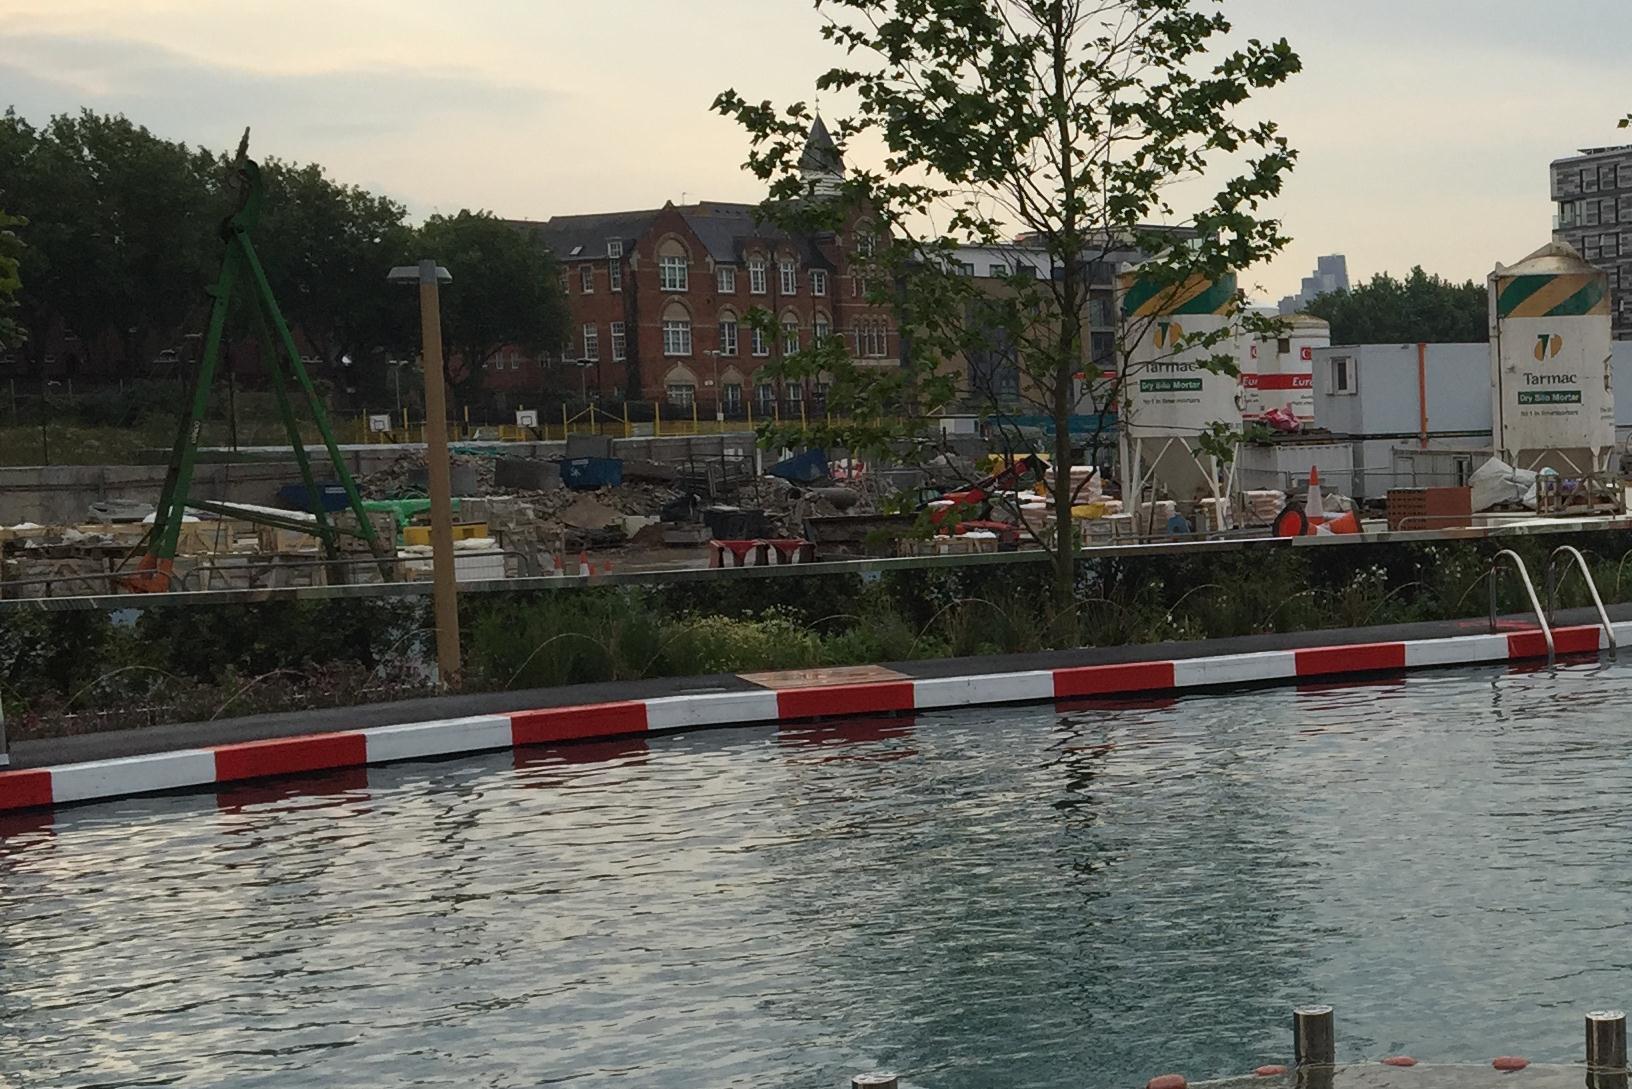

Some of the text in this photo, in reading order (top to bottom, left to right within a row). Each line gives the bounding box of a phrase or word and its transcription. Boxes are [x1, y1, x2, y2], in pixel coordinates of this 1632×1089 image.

[1173, 380, 1201, 389] Mortar
[1523, 373, 1577, 385] Tarmac
[1520, 393, 1533, 403] Dry
[1552, 392, 1580, 402] Mortar
